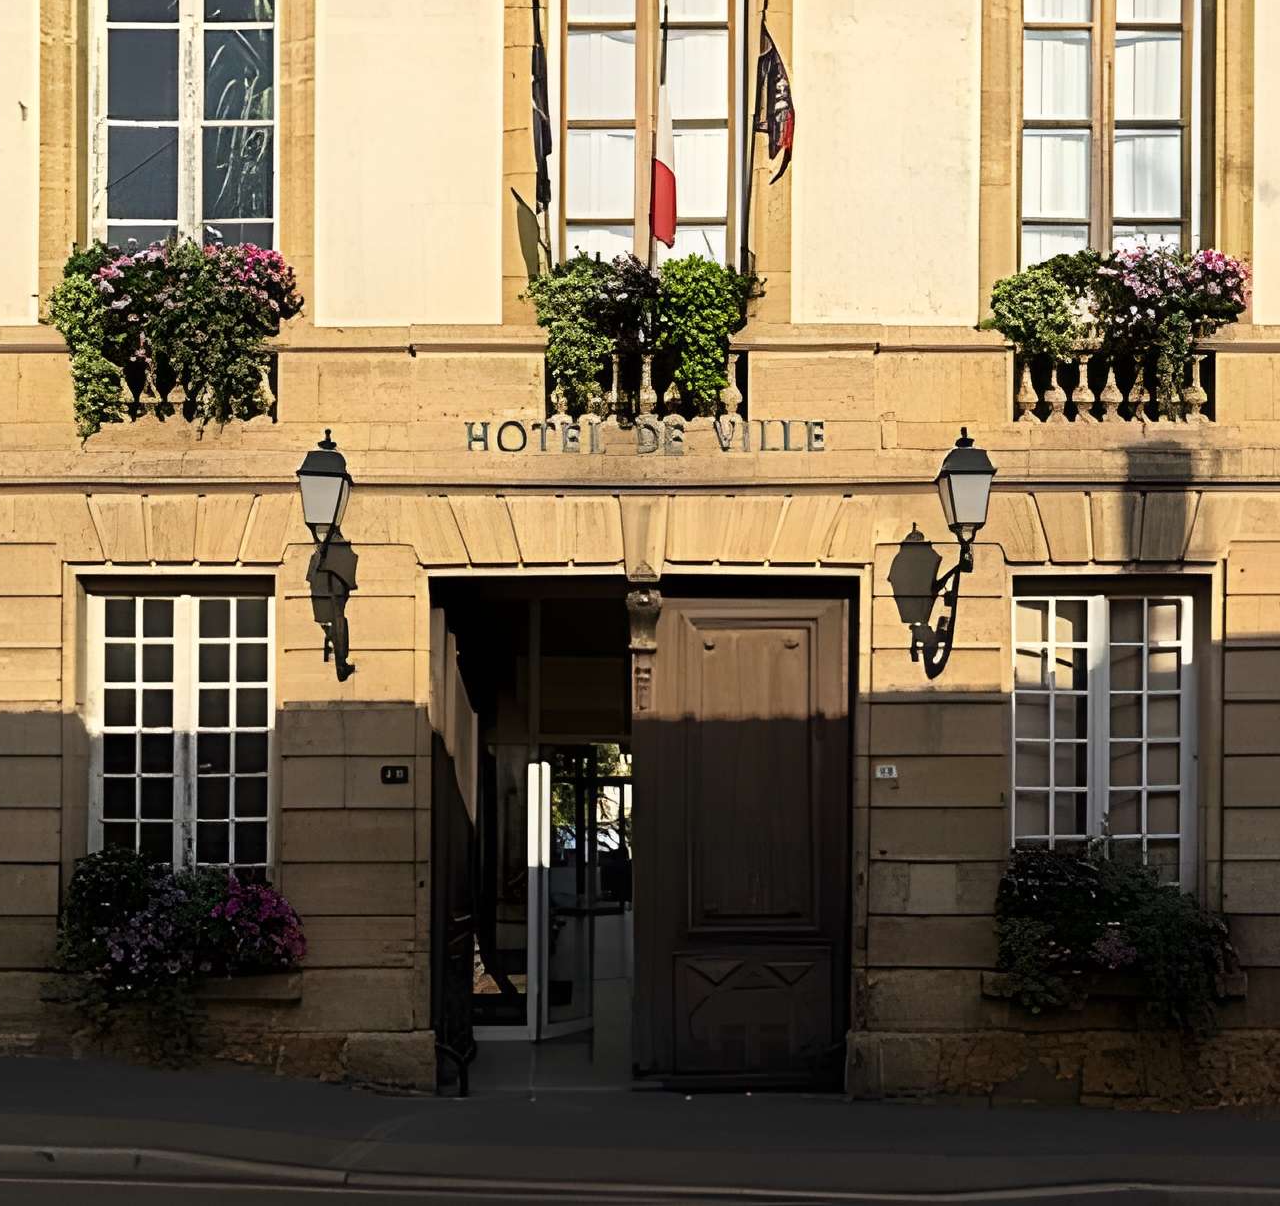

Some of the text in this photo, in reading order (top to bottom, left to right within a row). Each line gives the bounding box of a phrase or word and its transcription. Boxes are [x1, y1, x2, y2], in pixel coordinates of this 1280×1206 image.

[464, 420, 825, 456] HOTEL DE VILLE
